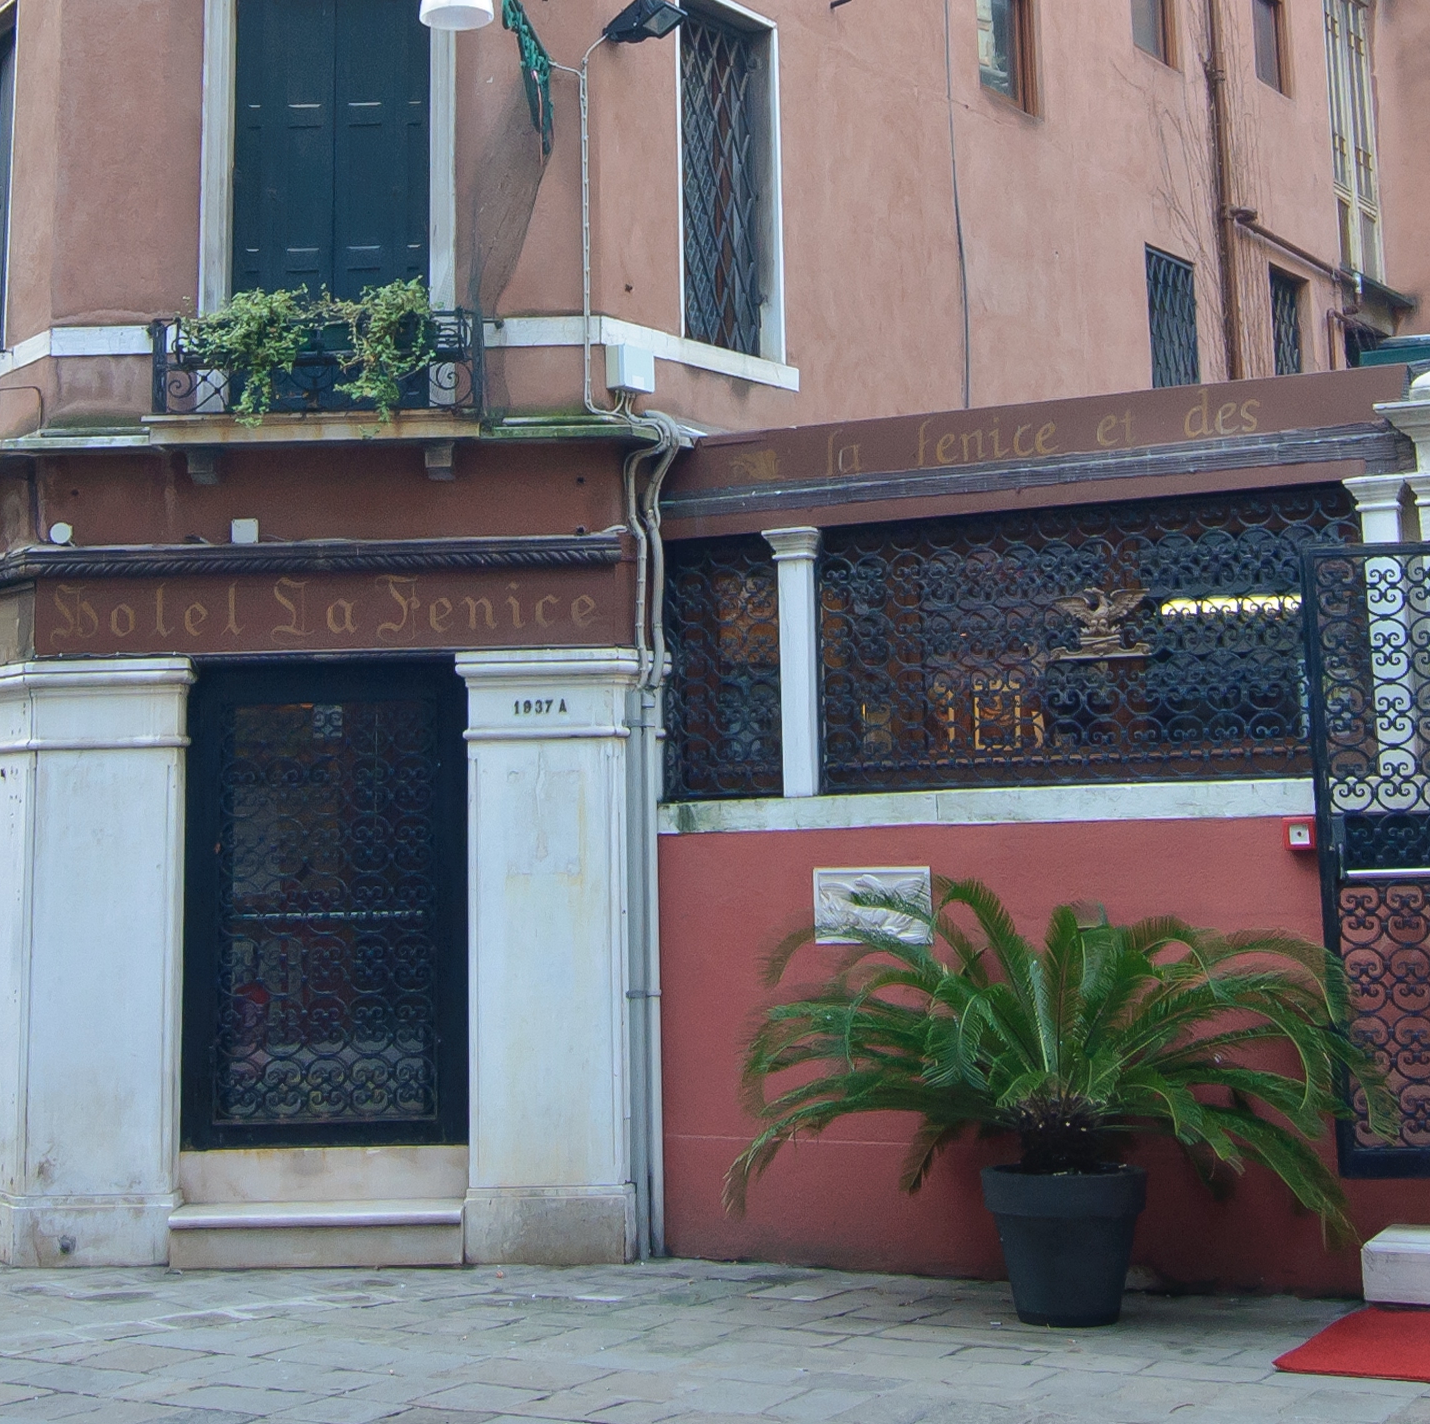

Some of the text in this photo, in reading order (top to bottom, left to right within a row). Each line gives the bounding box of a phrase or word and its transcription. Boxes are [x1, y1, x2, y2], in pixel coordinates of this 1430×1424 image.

[916, 416, 1061, 467] fenice
[1094, 408, 1138, 450] et
[1183, 386, 1263, 440] des
[48, 573, 601, 646] Hotel La Fenice
